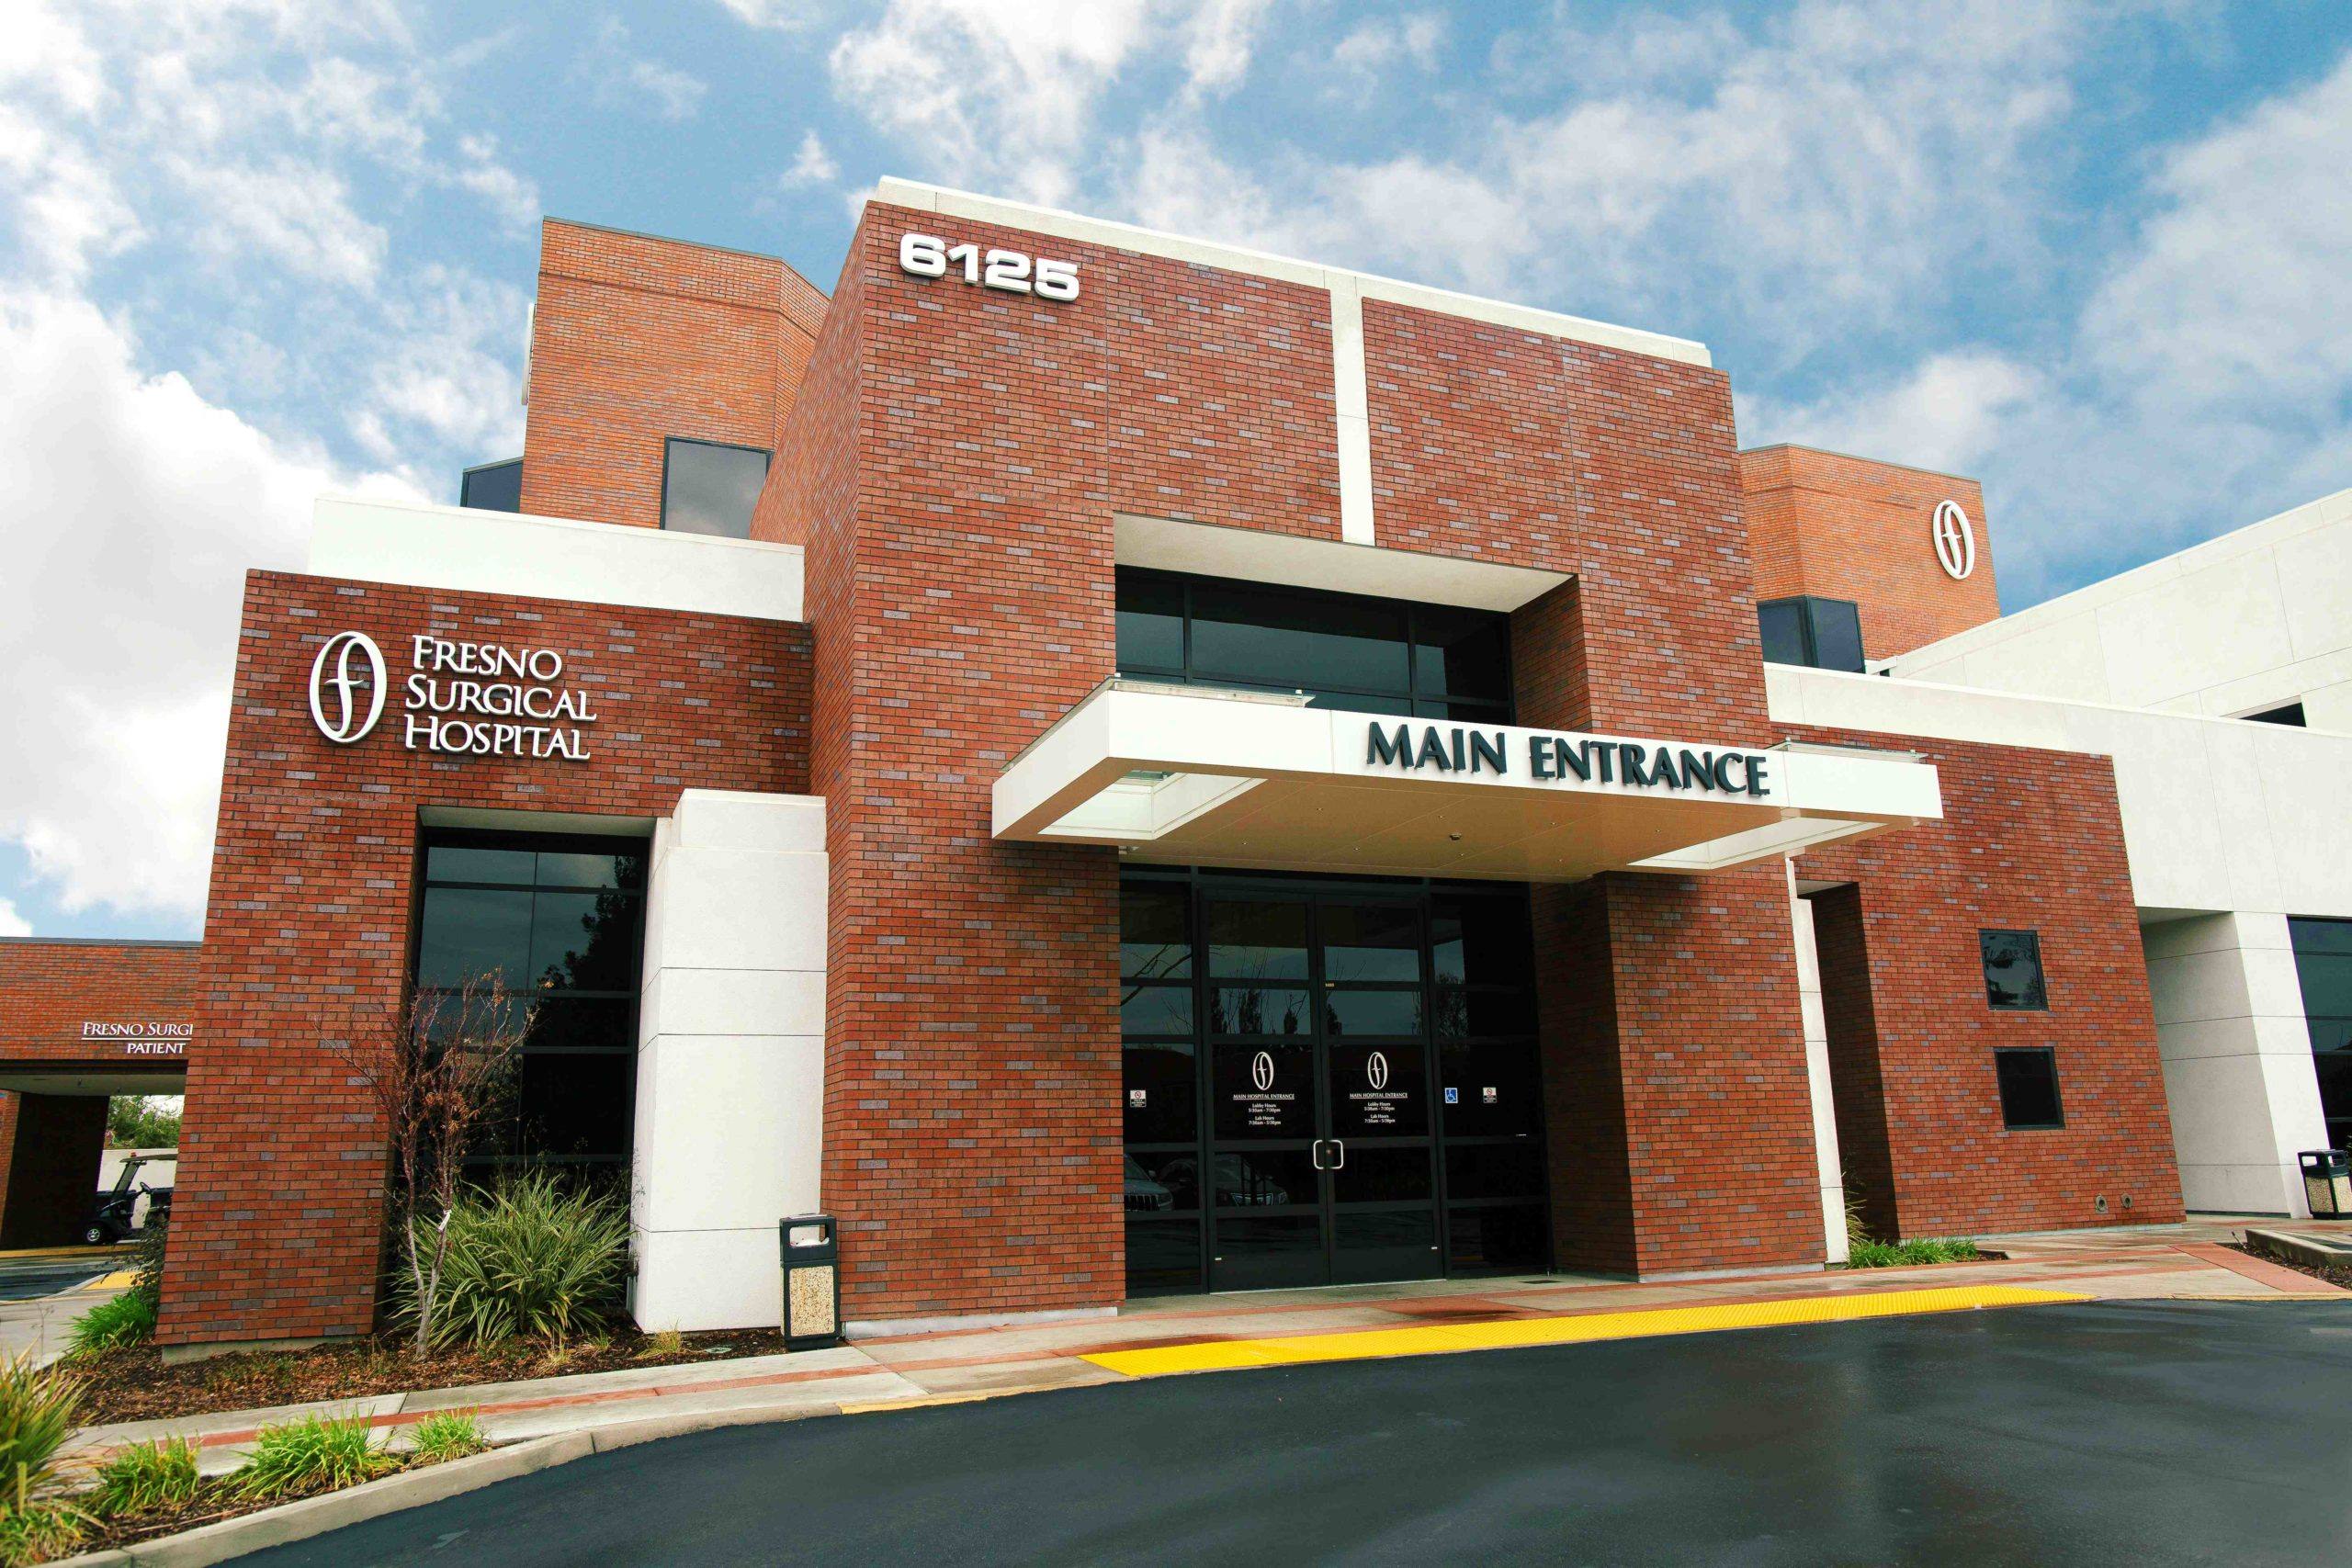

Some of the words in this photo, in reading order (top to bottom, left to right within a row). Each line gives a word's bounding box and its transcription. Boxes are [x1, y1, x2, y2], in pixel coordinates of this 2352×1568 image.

[899, 232, 1080, 301] 6125
[413, 635, 562, 682] FRESNO
[405, 673, 597, 721] SURGICAL
[403, 714, 591, 760] HOSPITAL
[1366, 721, 1506, 773] MAIN
[1529, 736, 1771, 796] ENTRANCE
[83, 1021, 143, 1036] FRESNO
[147, 1021, 194, 1036] SURGI
[127, 1043, 186, 1054] PATIENT
